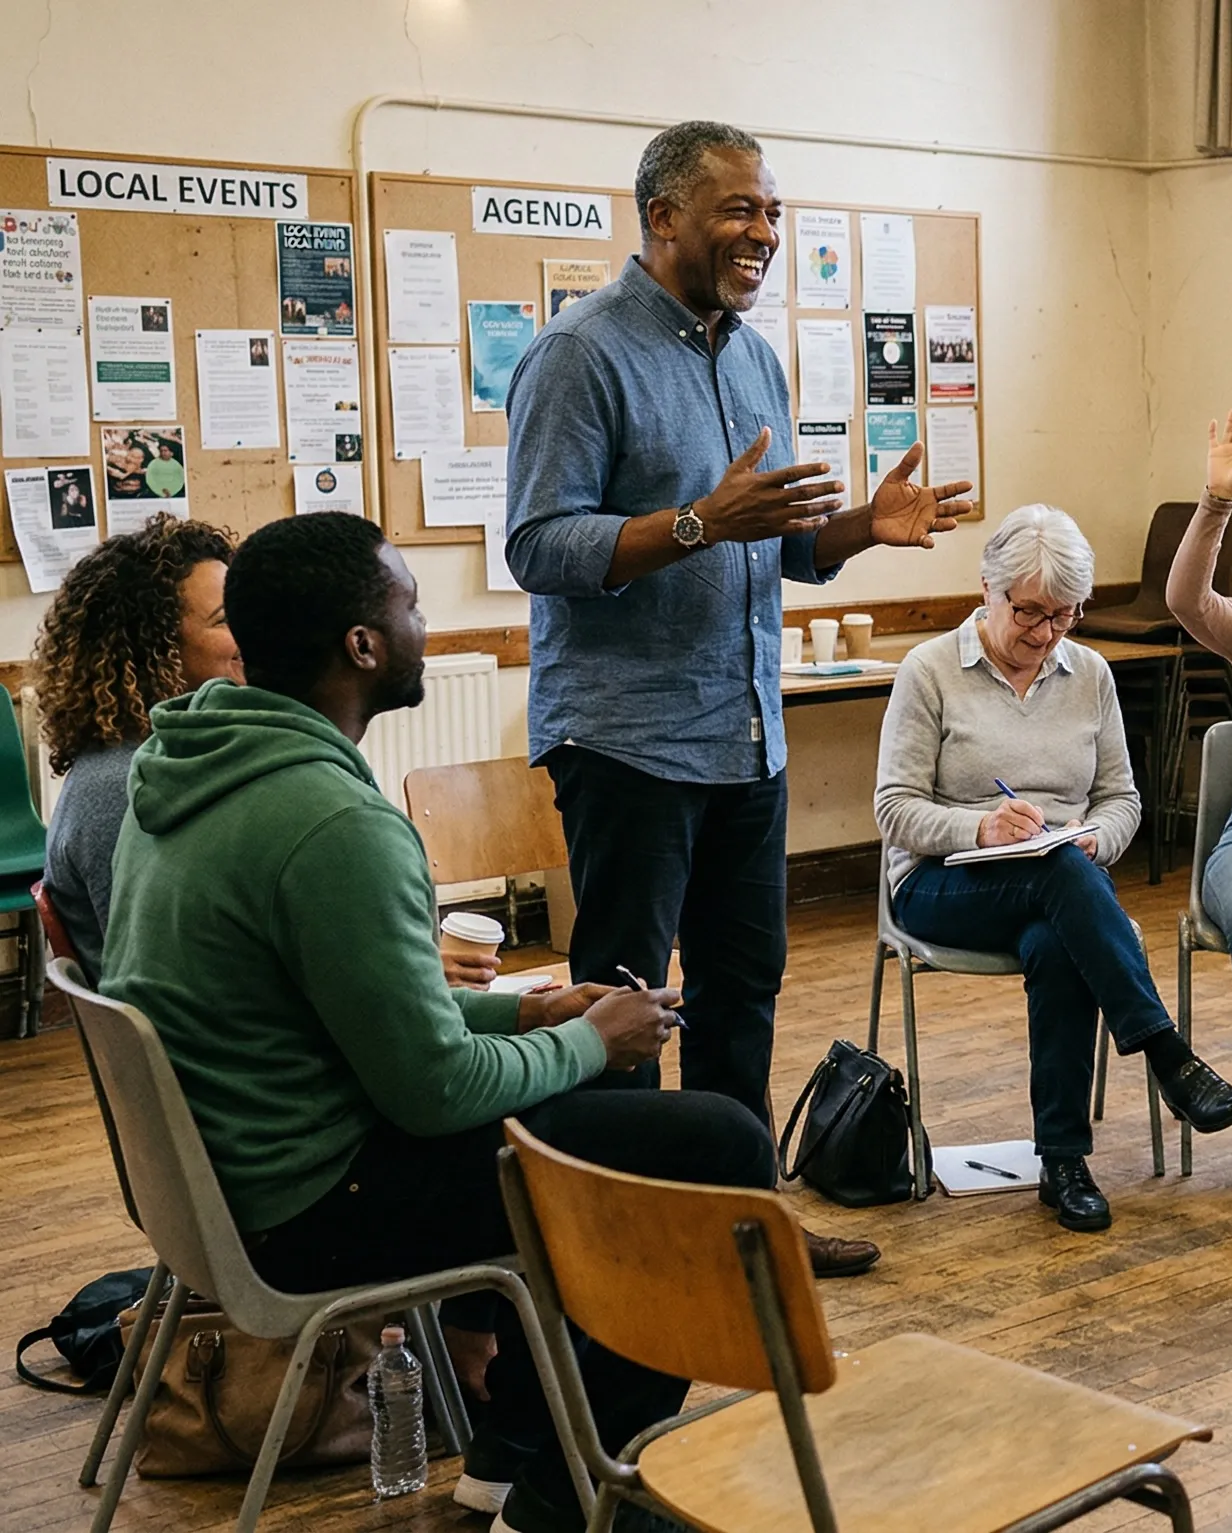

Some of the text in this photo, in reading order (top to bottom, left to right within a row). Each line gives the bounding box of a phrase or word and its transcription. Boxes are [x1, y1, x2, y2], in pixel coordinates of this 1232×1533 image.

[59, 169, 298, 209] LOCAL EVENTS
[482, 197, 602, 229] AGENDA
